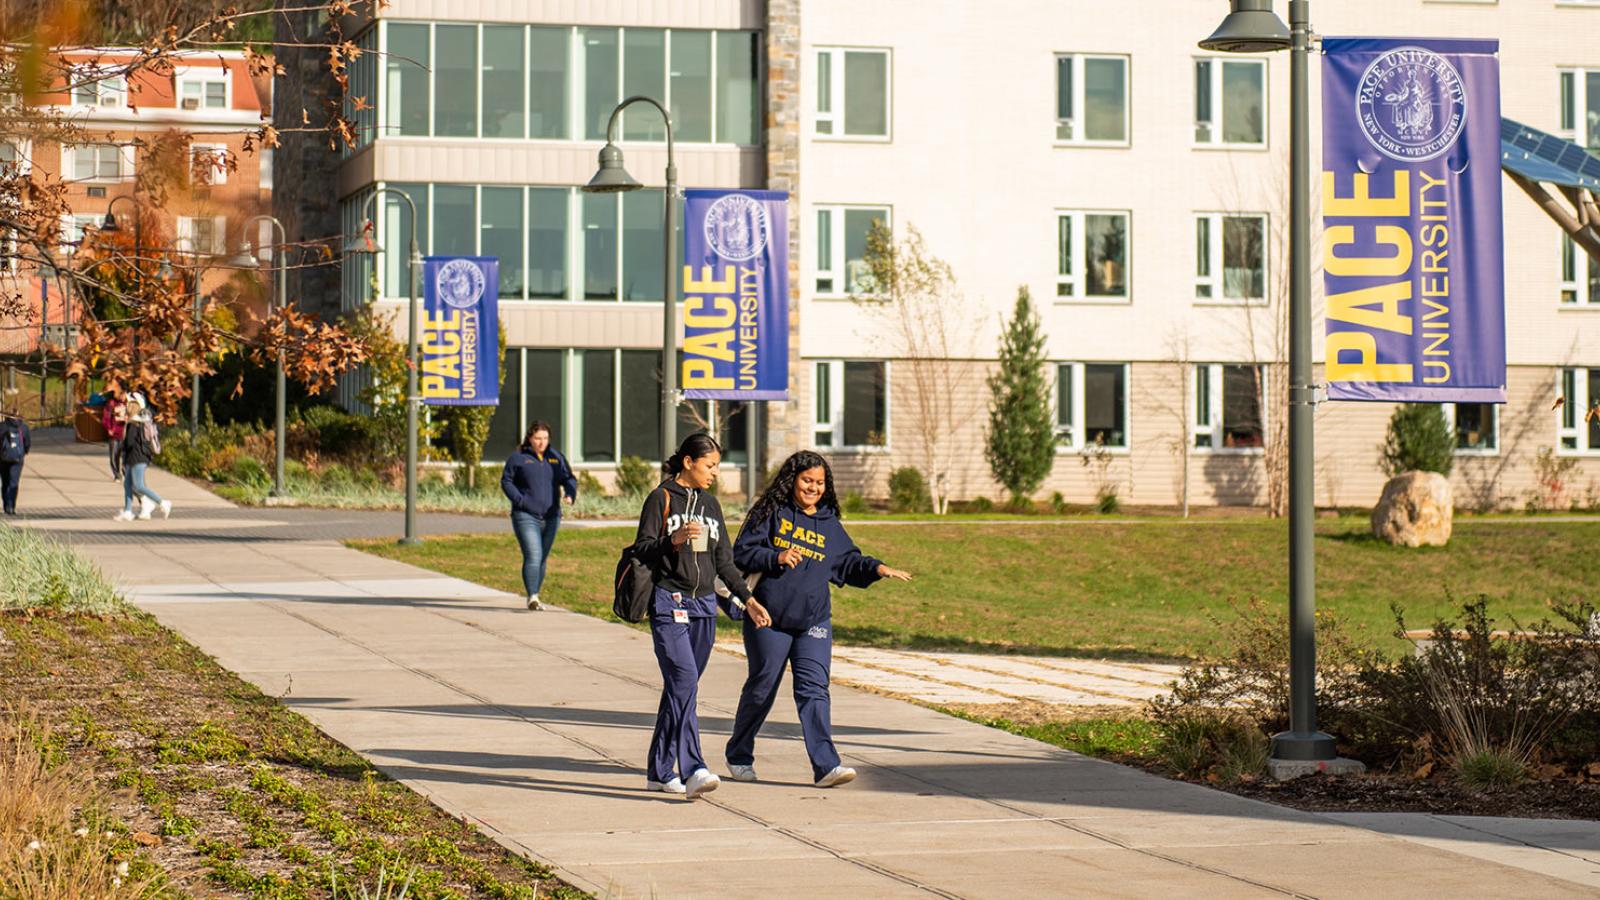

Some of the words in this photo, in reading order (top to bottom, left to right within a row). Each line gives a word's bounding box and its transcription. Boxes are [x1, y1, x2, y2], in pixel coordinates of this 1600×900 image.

[1360, 65, 1385, 104] PACE
[1385, 51, 1465, 105] UNIVERSITY
[1363, 113, 1379, 135] NEW
[1378, 135, 1401, 153] YORK
[1406, 113, 1460, 156] WESTCHESTER
[1322, 170, 1413, 383] PACE
[1419, 170, 1450, 384] UNIVERSITY
[422, 309, 461, 398] PACE
[462, 309, 476, 399] UNIVERSITY
[682, 265, 737, 389] PACE
[739, 266, 758, 390] UNIVERSITY
[779, 518, 826, 548] PACE
